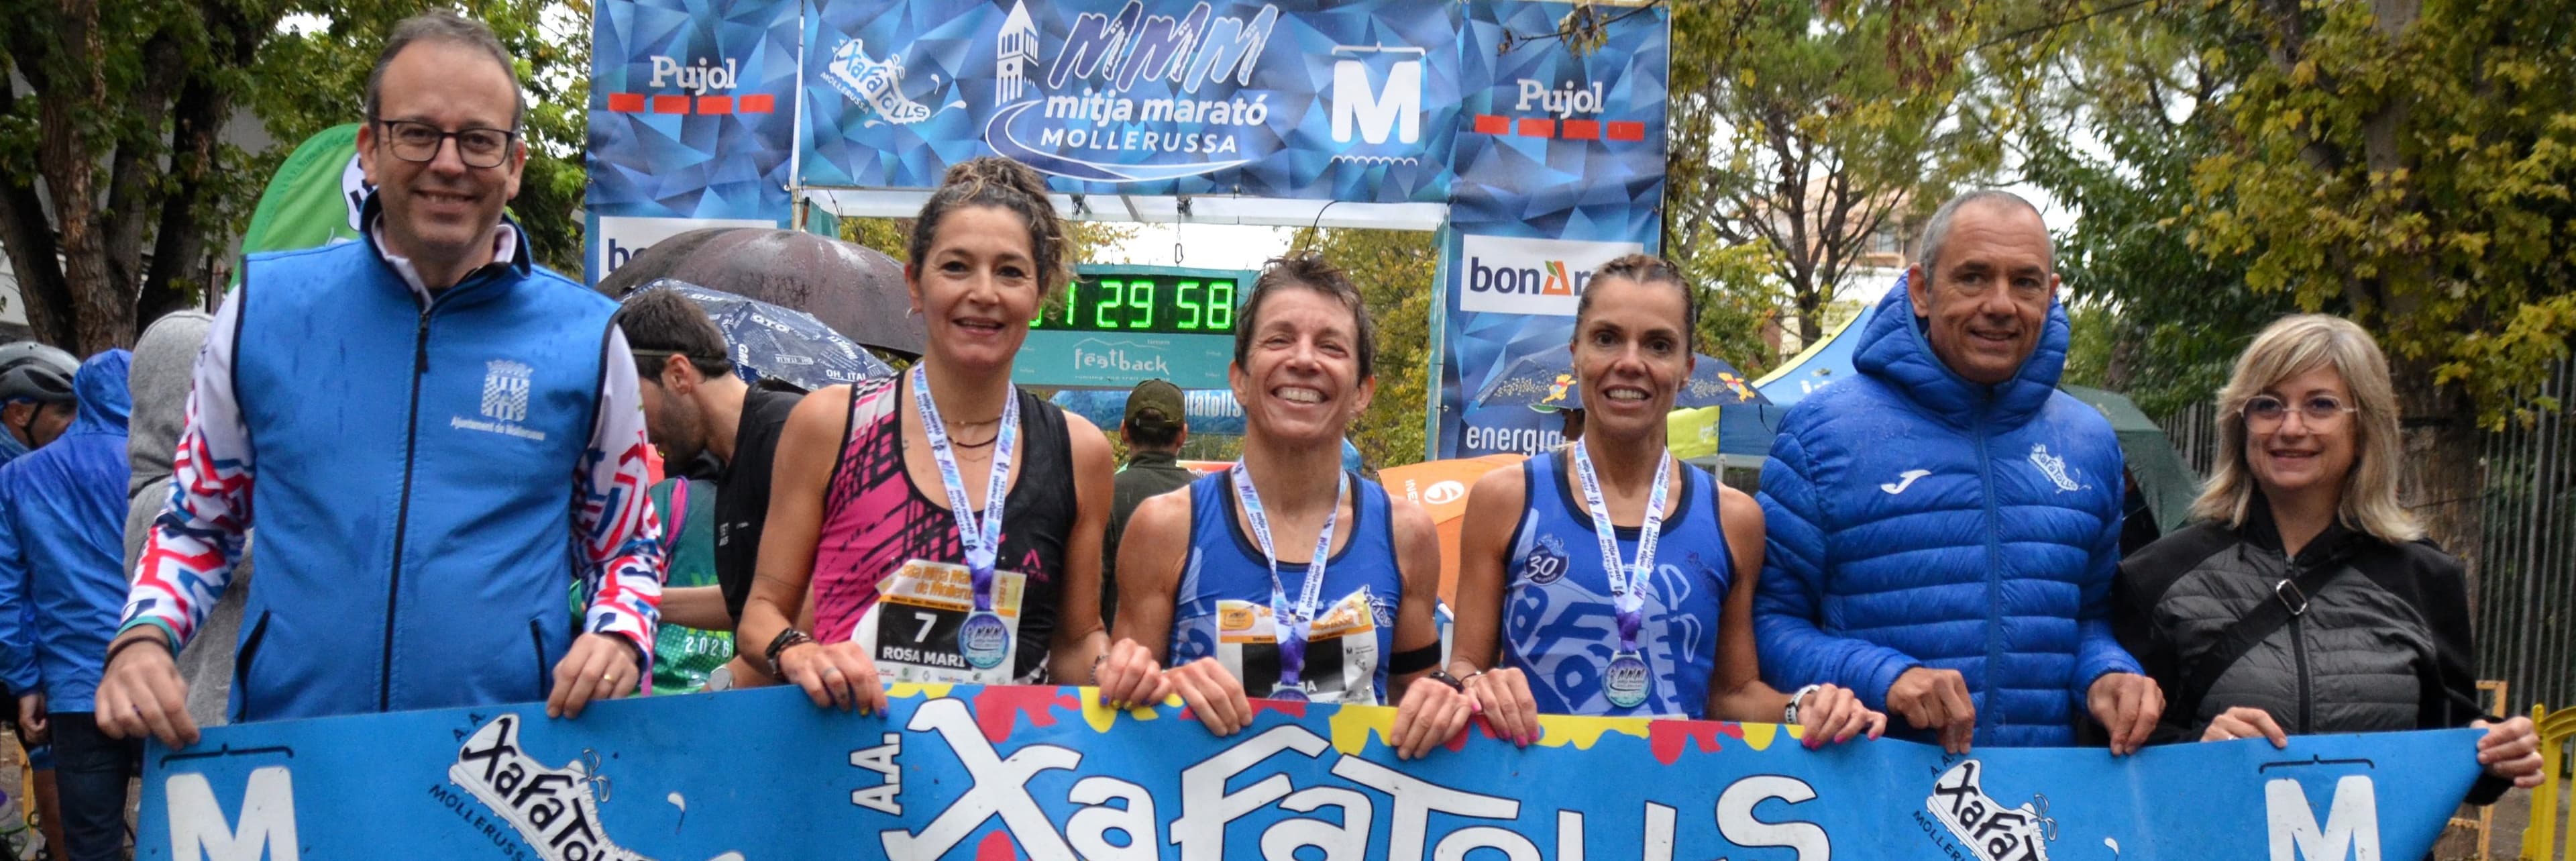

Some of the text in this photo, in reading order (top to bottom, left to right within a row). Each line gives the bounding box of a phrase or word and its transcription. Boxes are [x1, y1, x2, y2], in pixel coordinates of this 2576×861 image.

[649, 56, 738, 97] Pujol
[820, 71, 870, 115] MOLLERUSSA
[1044, 88, 1269, 128] mitja marató
[1332, 60, 1421, 144] M
[1515, 79, 1605, 119] Pujol
[1040, 127, 1238, 154] MOLLERUSSA
[1097, 280, 1155, 327] 29
[1176, 281, 1234, 330] 58
[1185, 390, 1242, 417] fatolls
[1524, 555, 1559, 578] 30
[914, 612, 937, 643] 7
[883, 646, 921, 663] ROSA
[165, 766, 300, 861] M
[429, 784, 527, 861] MOLLERUSS
[2264, 774, 2381, 861] M
